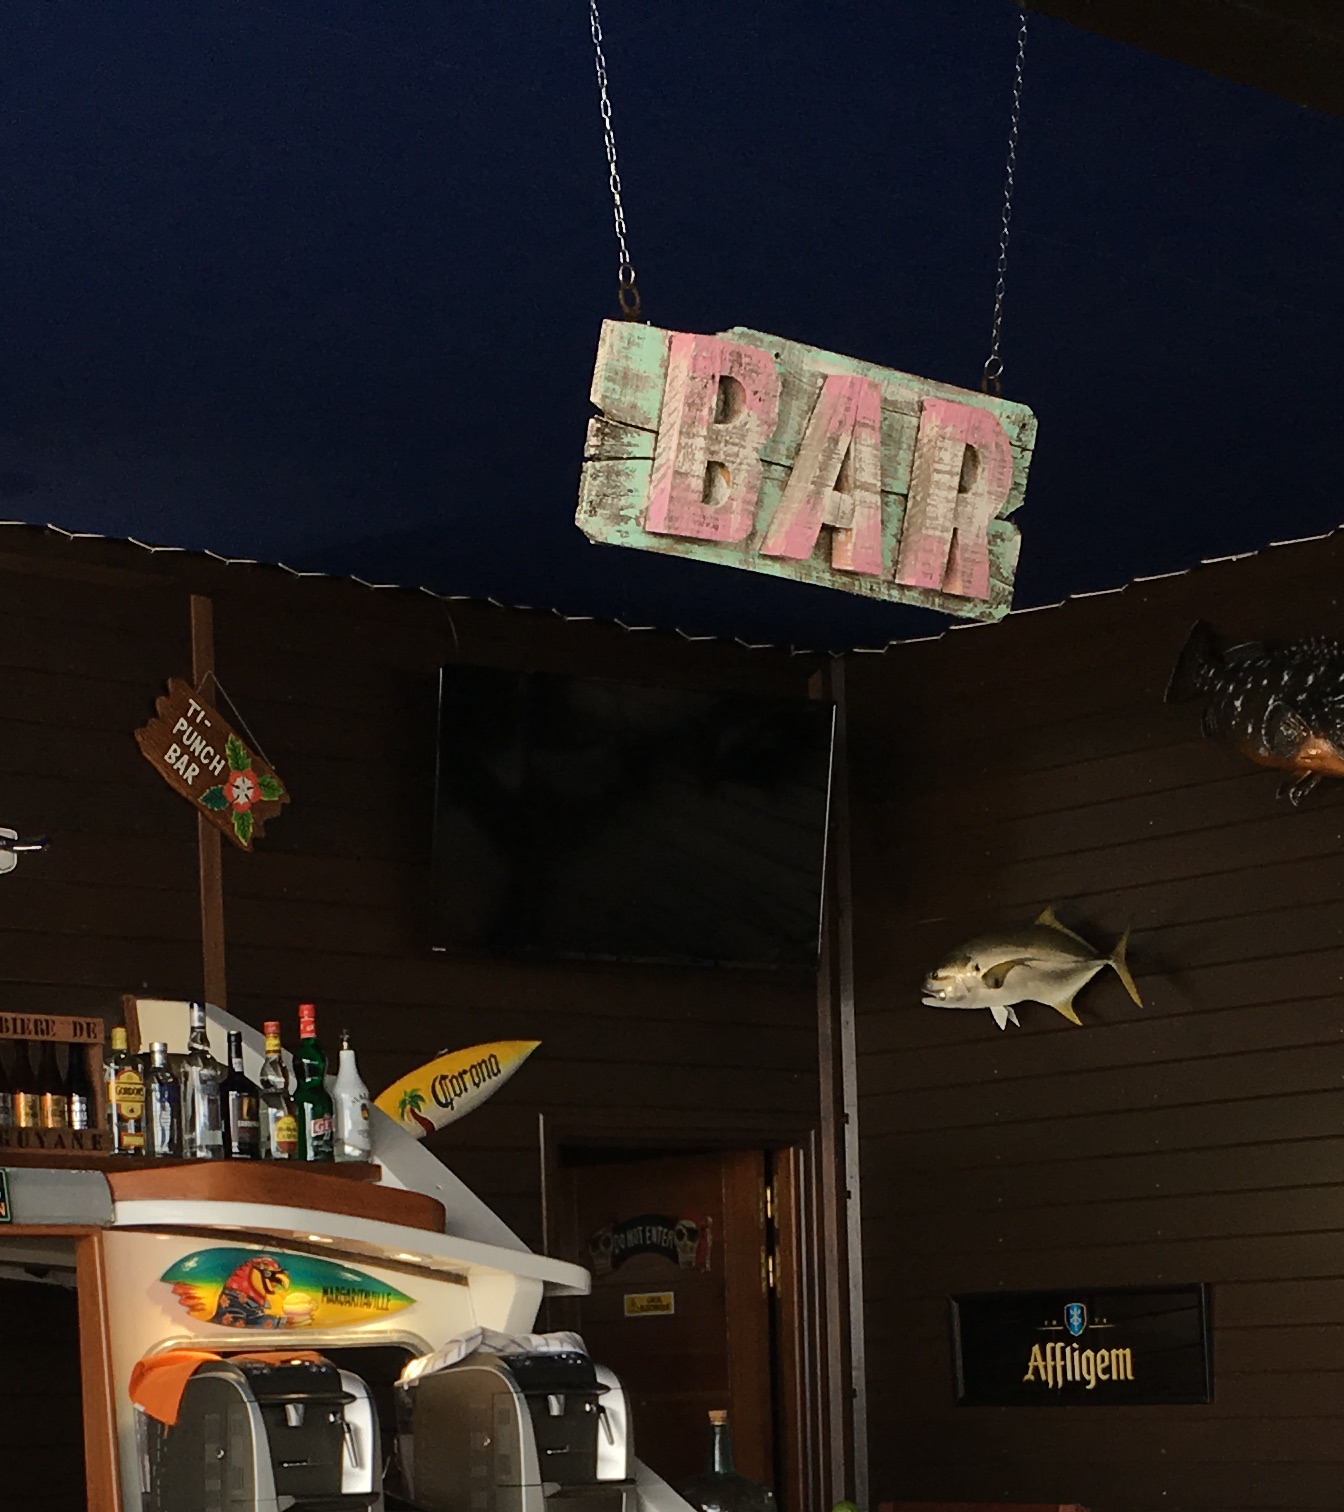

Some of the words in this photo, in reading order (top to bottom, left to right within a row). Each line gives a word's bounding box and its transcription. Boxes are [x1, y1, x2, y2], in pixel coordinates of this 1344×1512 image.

[645, 332, 1014, 600] BAR
[186, 698, 212, 728] TI-
[163, 742, 200, 786] BAR
[172, 716, 226, 777] PUNCH
[71, 1020, 98, 1039] DE
[431, 1053, 501, 1111] Corona
[626, 1226, 644, 1248] NOT
[321, 1286, 392, 1312] MARGARITAVILLE
[1022, 1341, 1135, 1390] Affligem
